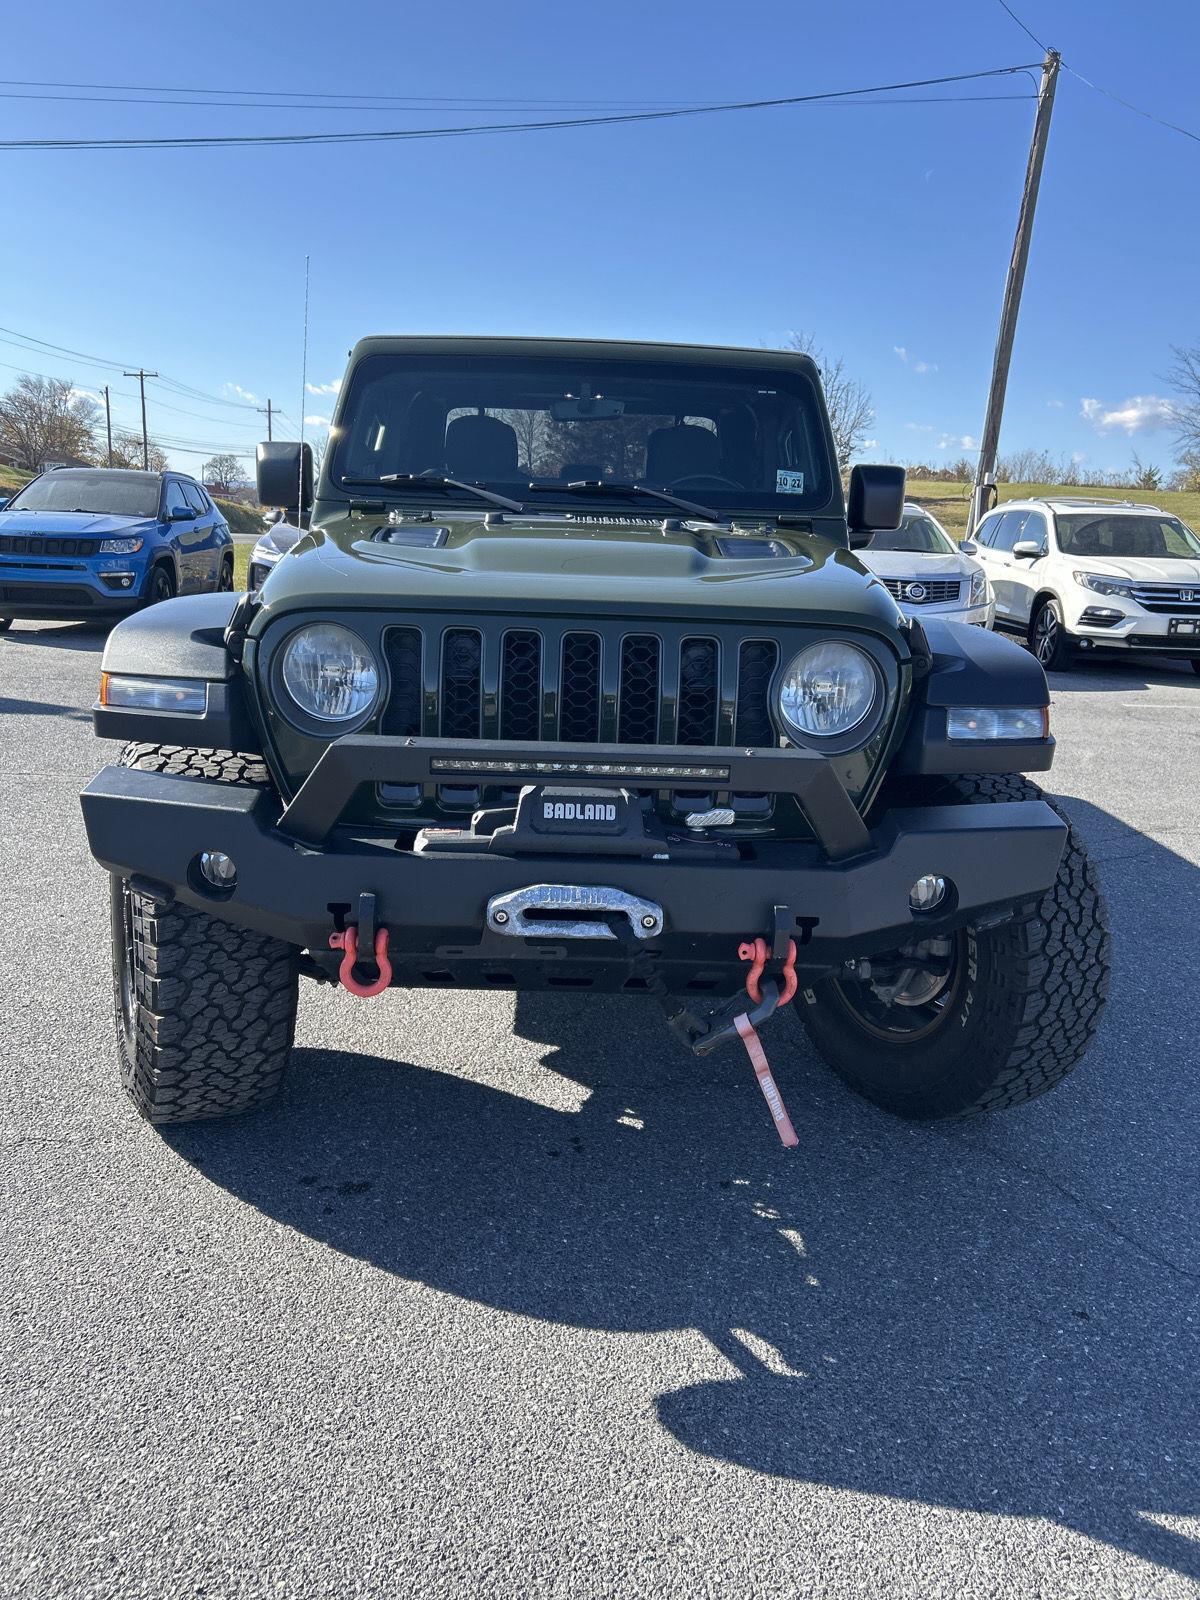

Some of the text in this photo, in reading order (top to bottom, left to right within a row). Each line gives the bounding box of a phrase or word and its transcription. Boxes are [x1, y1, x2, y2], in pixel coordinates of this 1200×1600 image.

[778, 477, 801, 488] 10 27
[543, 802, 616, 821] BADLAND
